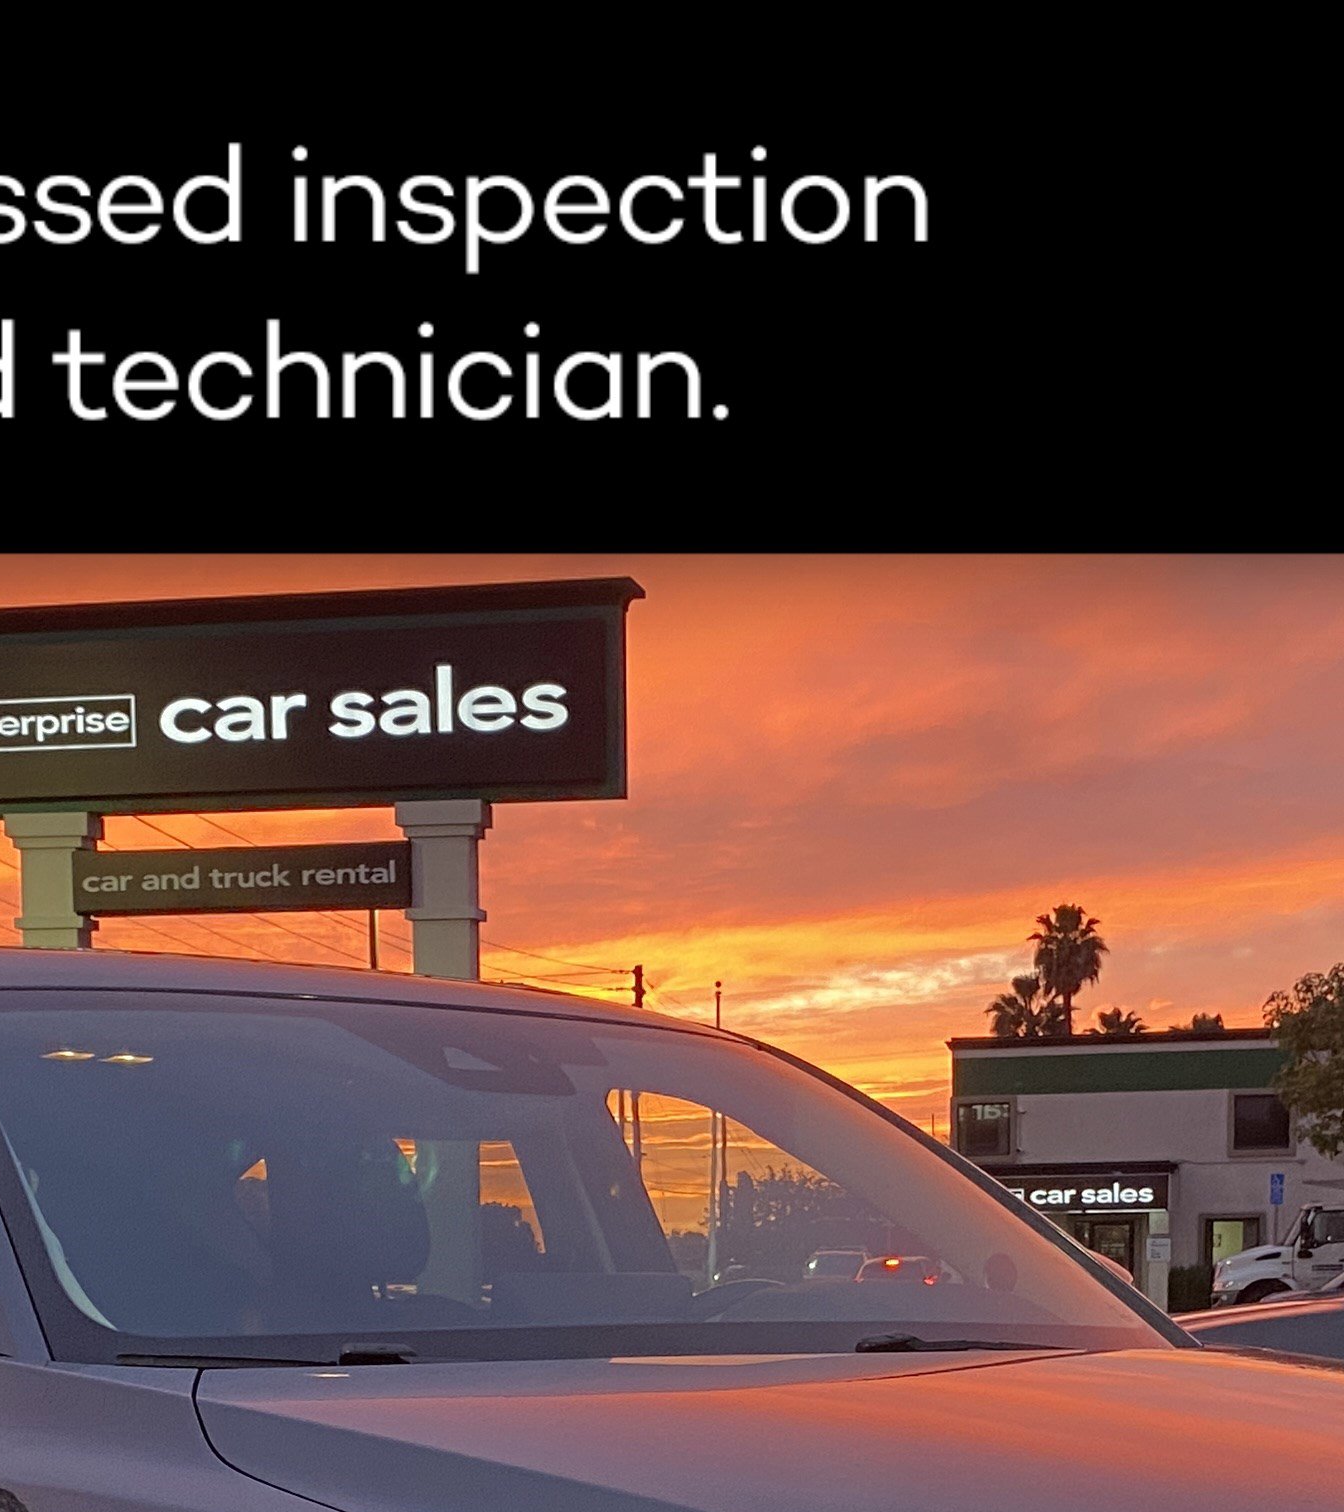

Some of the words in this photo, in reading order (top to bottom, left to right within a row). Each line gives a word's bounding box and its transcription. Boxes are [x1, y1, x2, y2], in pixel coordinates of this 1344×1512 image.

[159, 693, 308, 743] car
[328, 663, 568, 738] sales
[82, 874, 133, 893] car
[141, 866, 200, 891] and
[209, 863, 291, 888] truck
[301, 860, 396, 886] rental
[1029, 1188, 1077, 1204] car
[1081, 1181, 1154, 1204] sales
